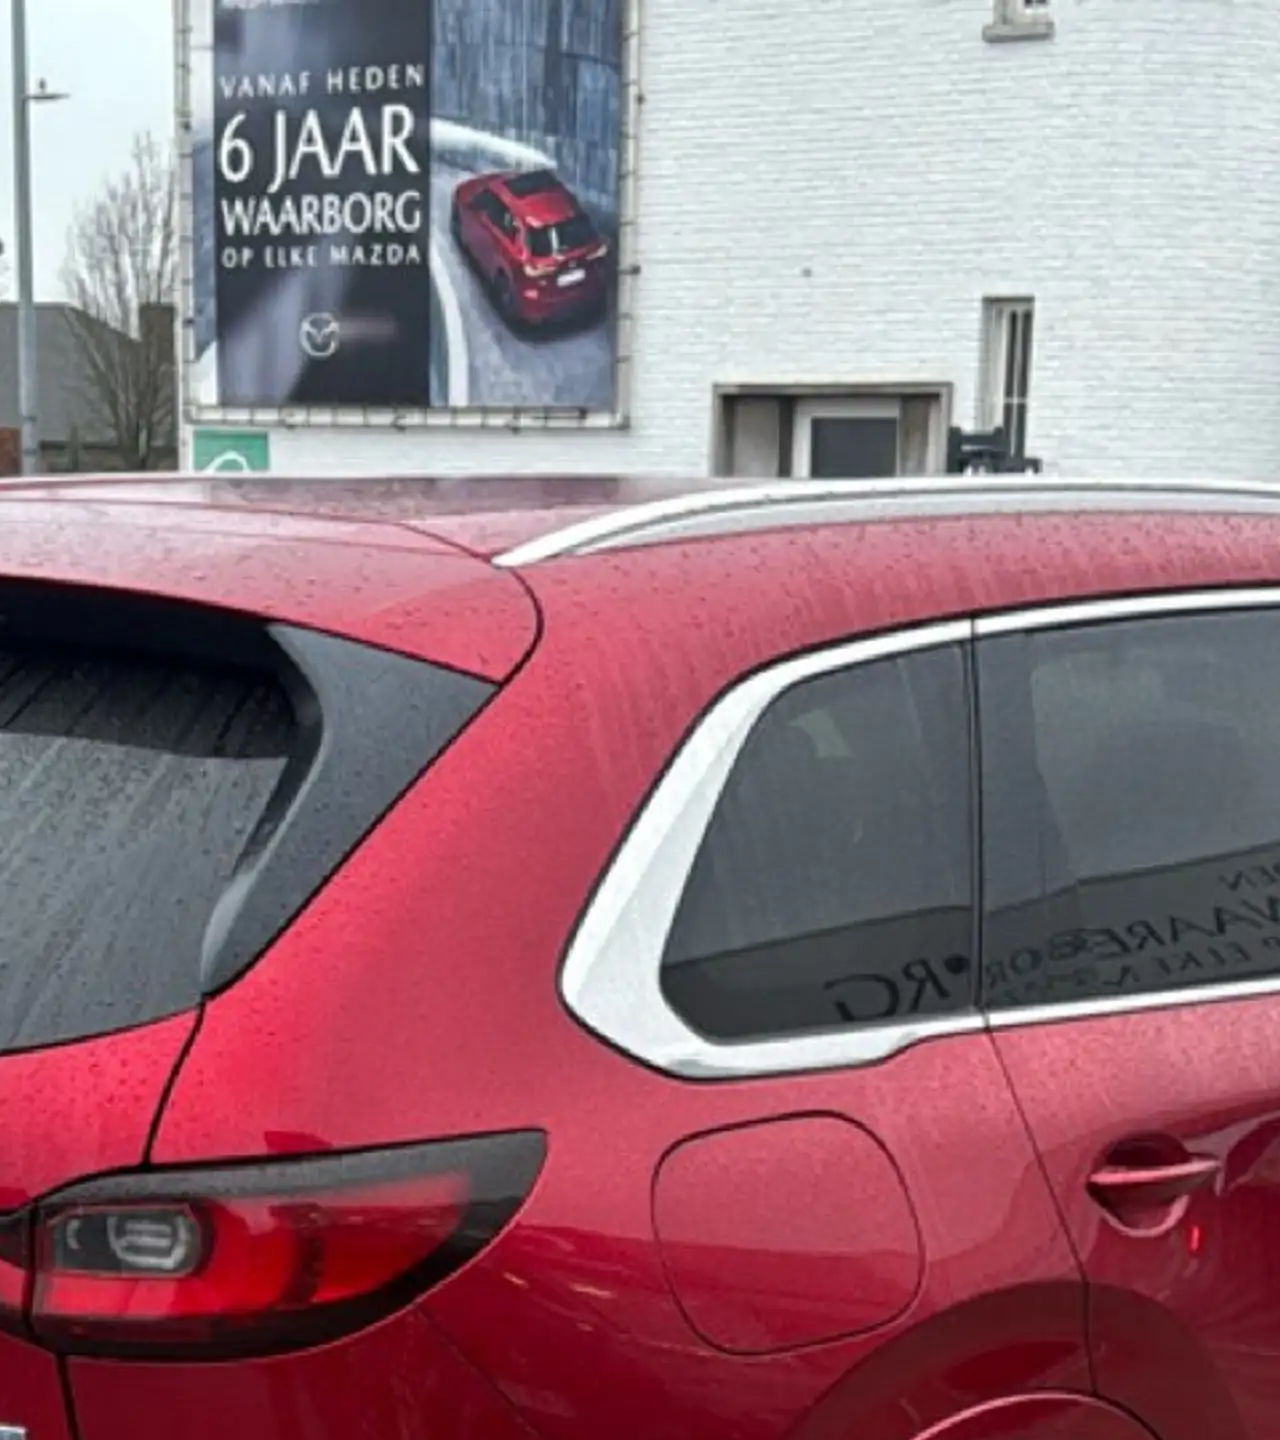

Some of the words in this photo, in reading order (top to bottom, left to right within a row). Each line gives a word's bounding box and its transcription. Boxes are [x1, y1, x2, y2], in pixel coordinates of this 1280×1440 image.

[220, 71, 311, 98] VANAF
[327, 63, 424, 94] HEDEN
[220, 111, 254, 183] 6
[267, 103, 421, 193] JAAR
[221, 190, 421, 236] WAARBORG
[222, 246, 255, 269] OP
[264, 245, 319, 268] ELKE
[329, 243, 421, 266] MAZDA
